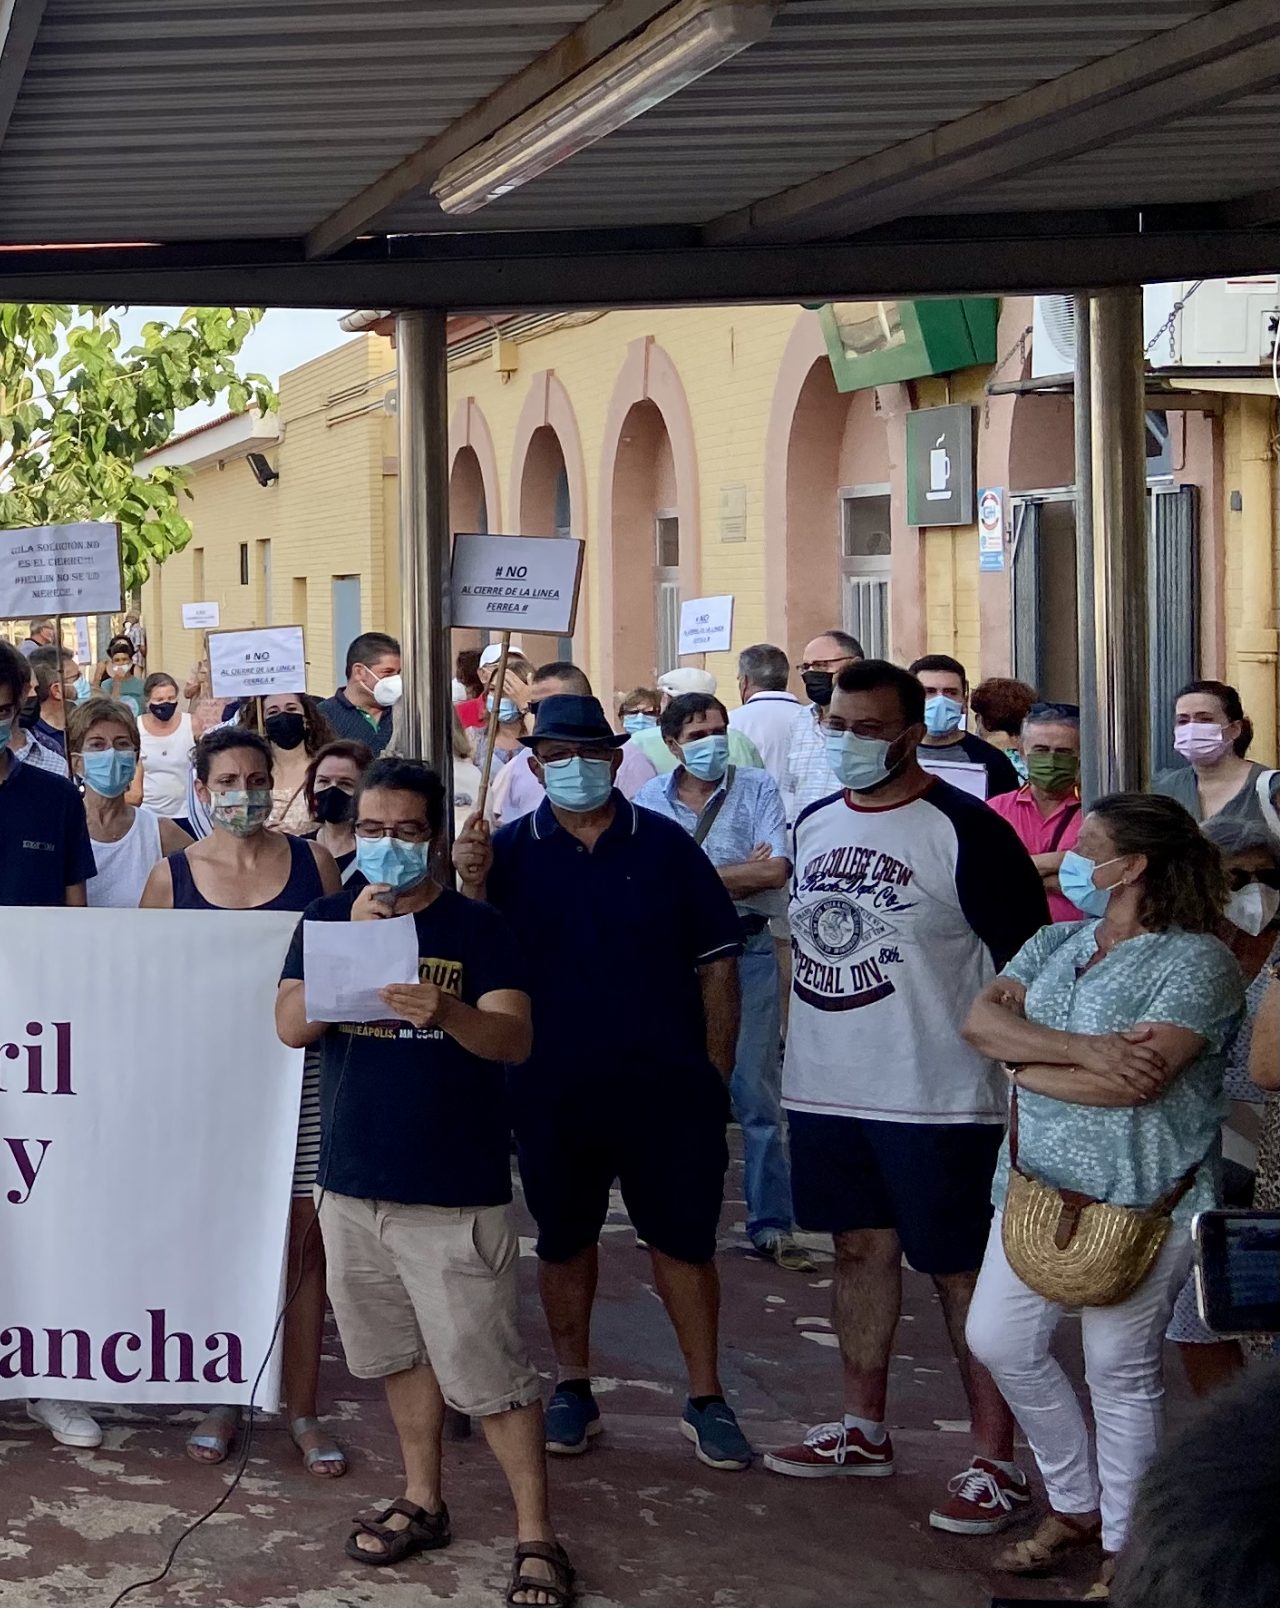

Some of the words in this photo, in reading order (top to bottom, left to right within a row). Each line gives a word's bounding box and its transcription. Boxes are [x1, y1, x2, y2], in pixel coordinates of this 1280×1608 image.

[33, 558, 45, 567] EL
[495, 566, 503, 577] #
[505, 566, 527, 578] NO
[461, 585, 471, 594] AL
[473, 586, 502, 596] CIERRE
[504, 587, 517, 597] DE
[519, 588, 530, 597] LA
[532, 588, 560, 598] LINEA
[486, 602, 520, 612] FERREA
[521, 604, 529, 612] #
[253, 651, 270, 660] NO
[823, 846, 877, 878] COLLEGE
[872, 853, 913, 887] CREW
[878, 946, 904, 964] 89th
[850, 956, 888, 992] DIV.
[3, 1137, 53, 1205] y
